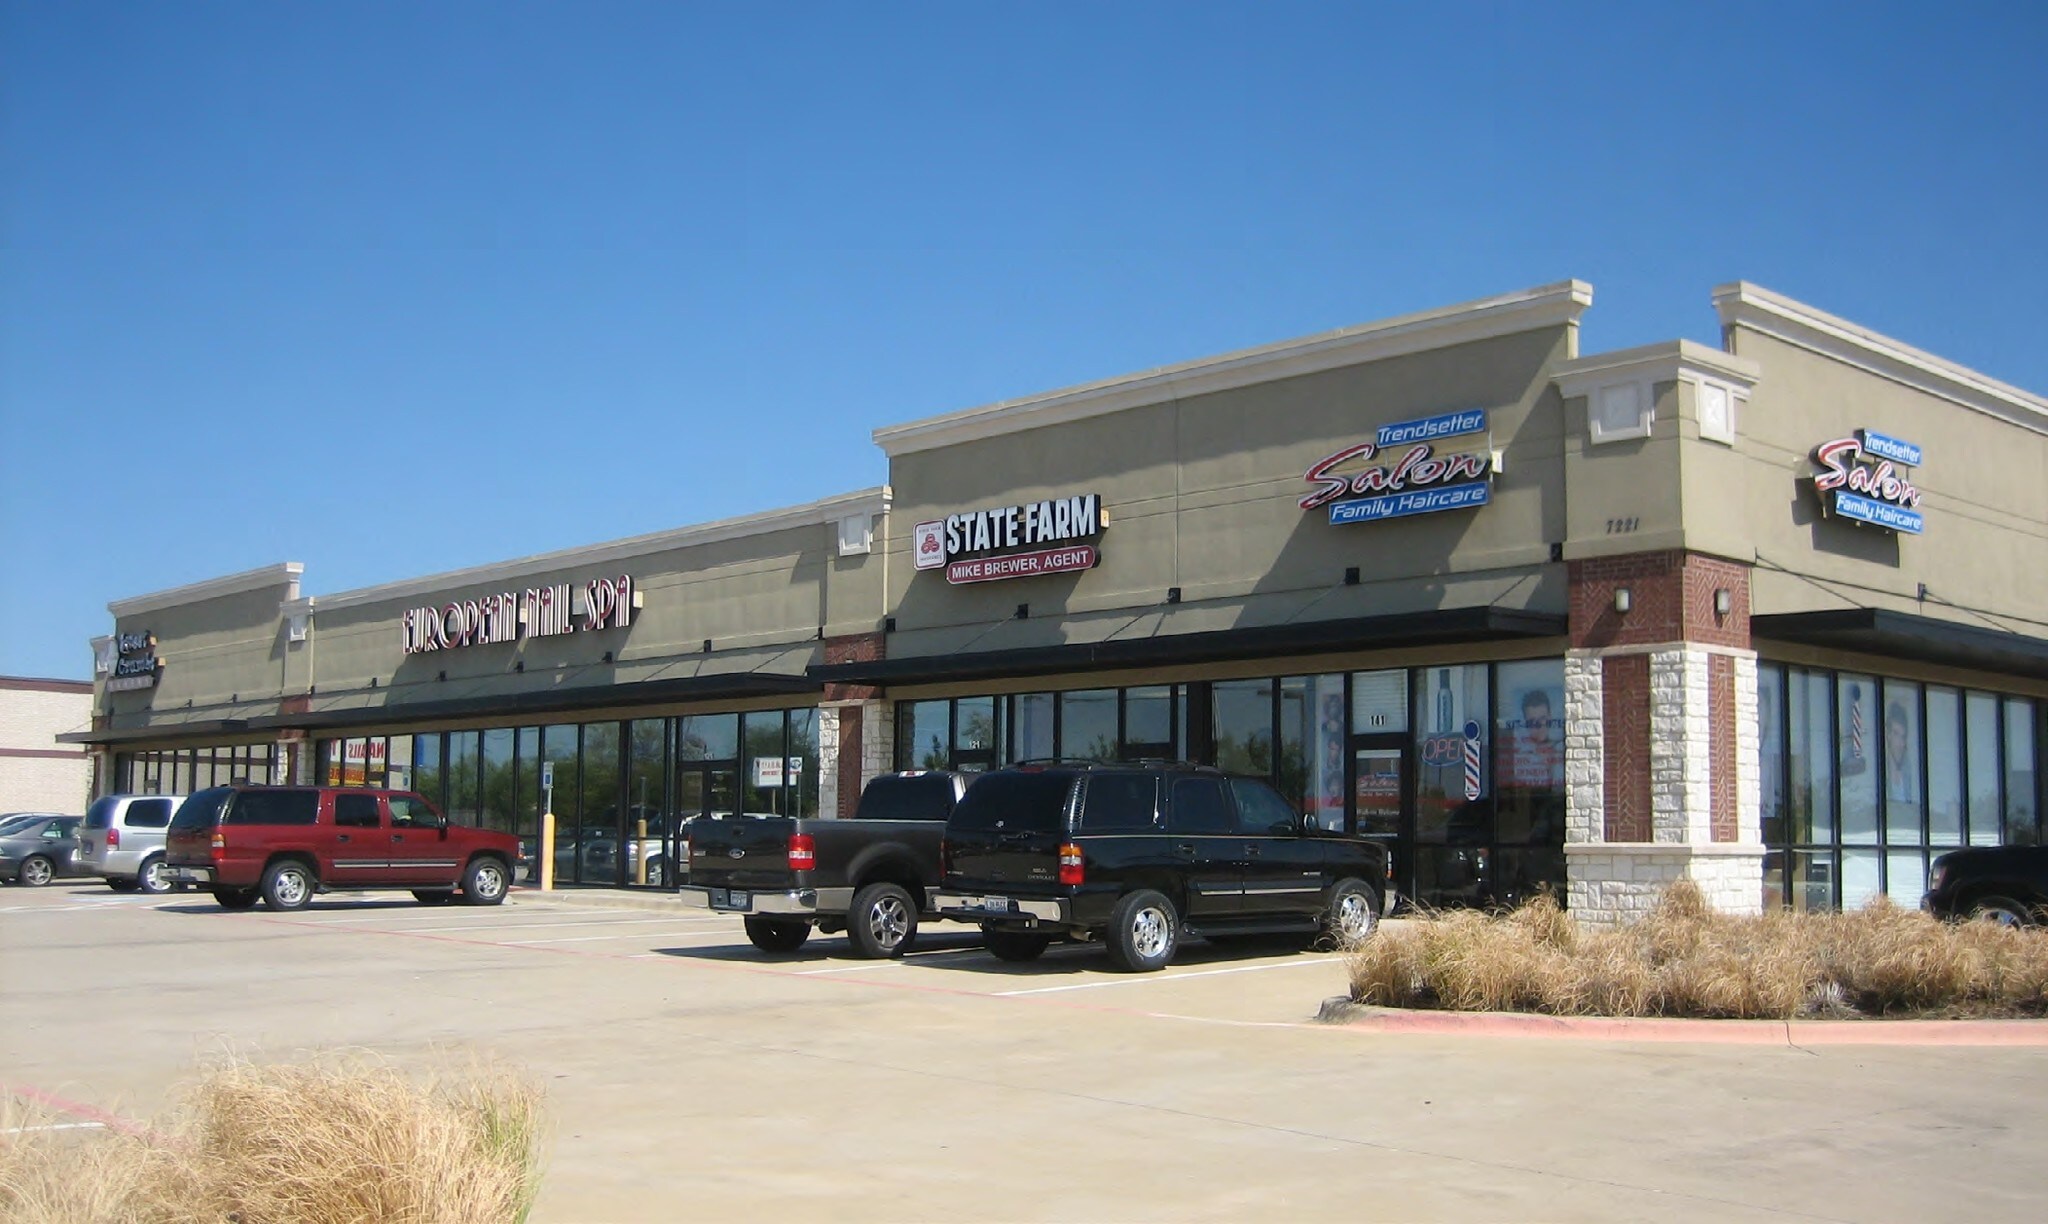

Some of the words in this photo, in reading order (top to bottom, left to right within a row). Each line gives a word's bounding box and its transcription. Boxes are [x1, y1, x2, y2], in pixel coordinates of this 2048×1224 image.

[1378, 414, 1483, 444] Trendsetter
[1864, 432, 1920, 463] Trendsetter
[1298, 443, 1486, 510] Salon
[1815, 438, 1921, 507] Salon
[1331, 499, 1395, 521] Family
[1398, 487, 1485, 512] Haircare
[1836, 495, 1875, 520] Family
[1875, 506, 1921, 529] Haircare
[946, 506, 1019, 554] STATE
[1025, 494, 1096, 544] FARM
[952, 564, 982, 579] MIKE
[984, 557, 1041, 576] BREWER,
[1044, 550, 1089, 568] AGENT
[402, 592, 518, 654] EUROPEAN
[525, 583, 573, 638] NAIL
[583, 574, 632, 631] SPA
[1370, 715, 1385, 726] 141
